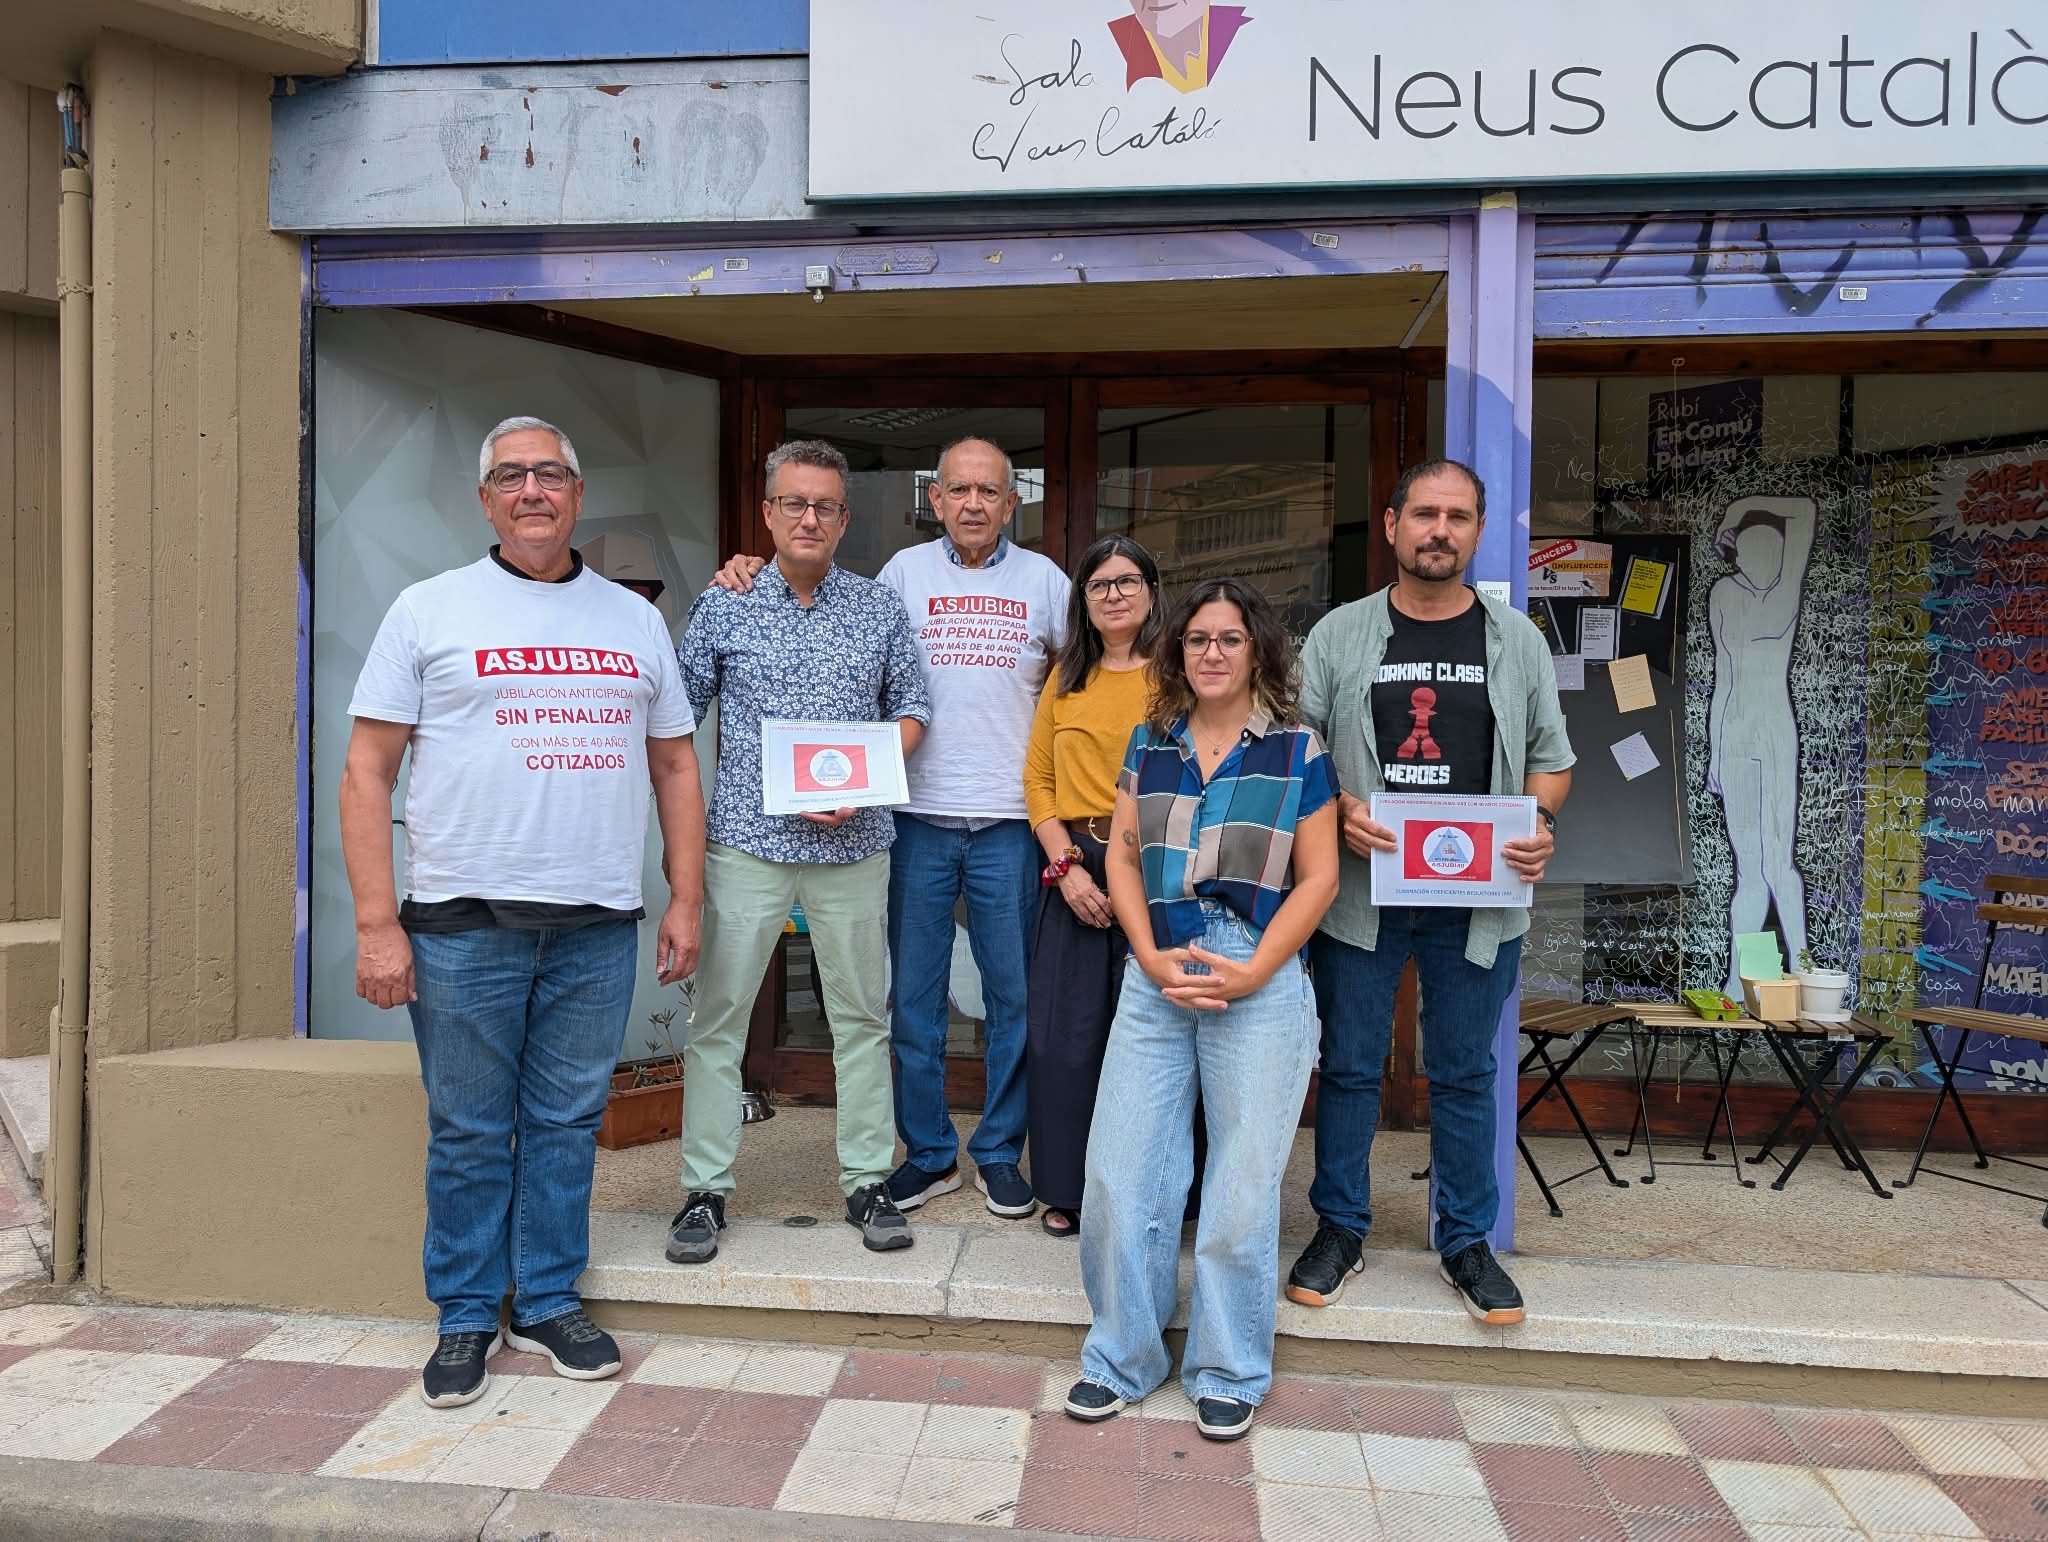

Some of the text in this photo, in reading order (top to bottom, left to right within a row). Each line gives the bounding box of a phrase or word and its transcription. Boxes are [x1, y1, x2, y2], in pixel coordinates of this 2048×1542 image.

[1000, 33, 1096, 105] Sala
[1309, 28, 2048, 143] Neus Català
[1657, 396, 1699, 420] Rubí
[1656, 446, 1737, 472] Podem
[1551, 561, 1609, 570] (IN)FLUENCERS
[933, 597, 1023, 617] ASJUBI40
[926, 616, 1026, 630] JUBILACIÓN ANTICIPADA
[919, 627, 1029, 645] SIN PENALIZAR
[925, 641, 1022, 655] CON MÁS DE 40 AÑOS
[483, 650, 634, 674] ASJUBI40
[930, 653, 1017, 669] COTIZADOS
[1373, 662, 1485, 684] ORKING CLASS
[494, 687, 634, 700] JUBILACIÓN ANTICIPADA
[495, 708, 632, 726] SIN PENALIZAR
[511, 735, 628, 749] CON MÁS DE 40 AÑOS
[526, 754, 626, 771] COTIZADOS
[1383, 763, 1451, 785] HEROES
